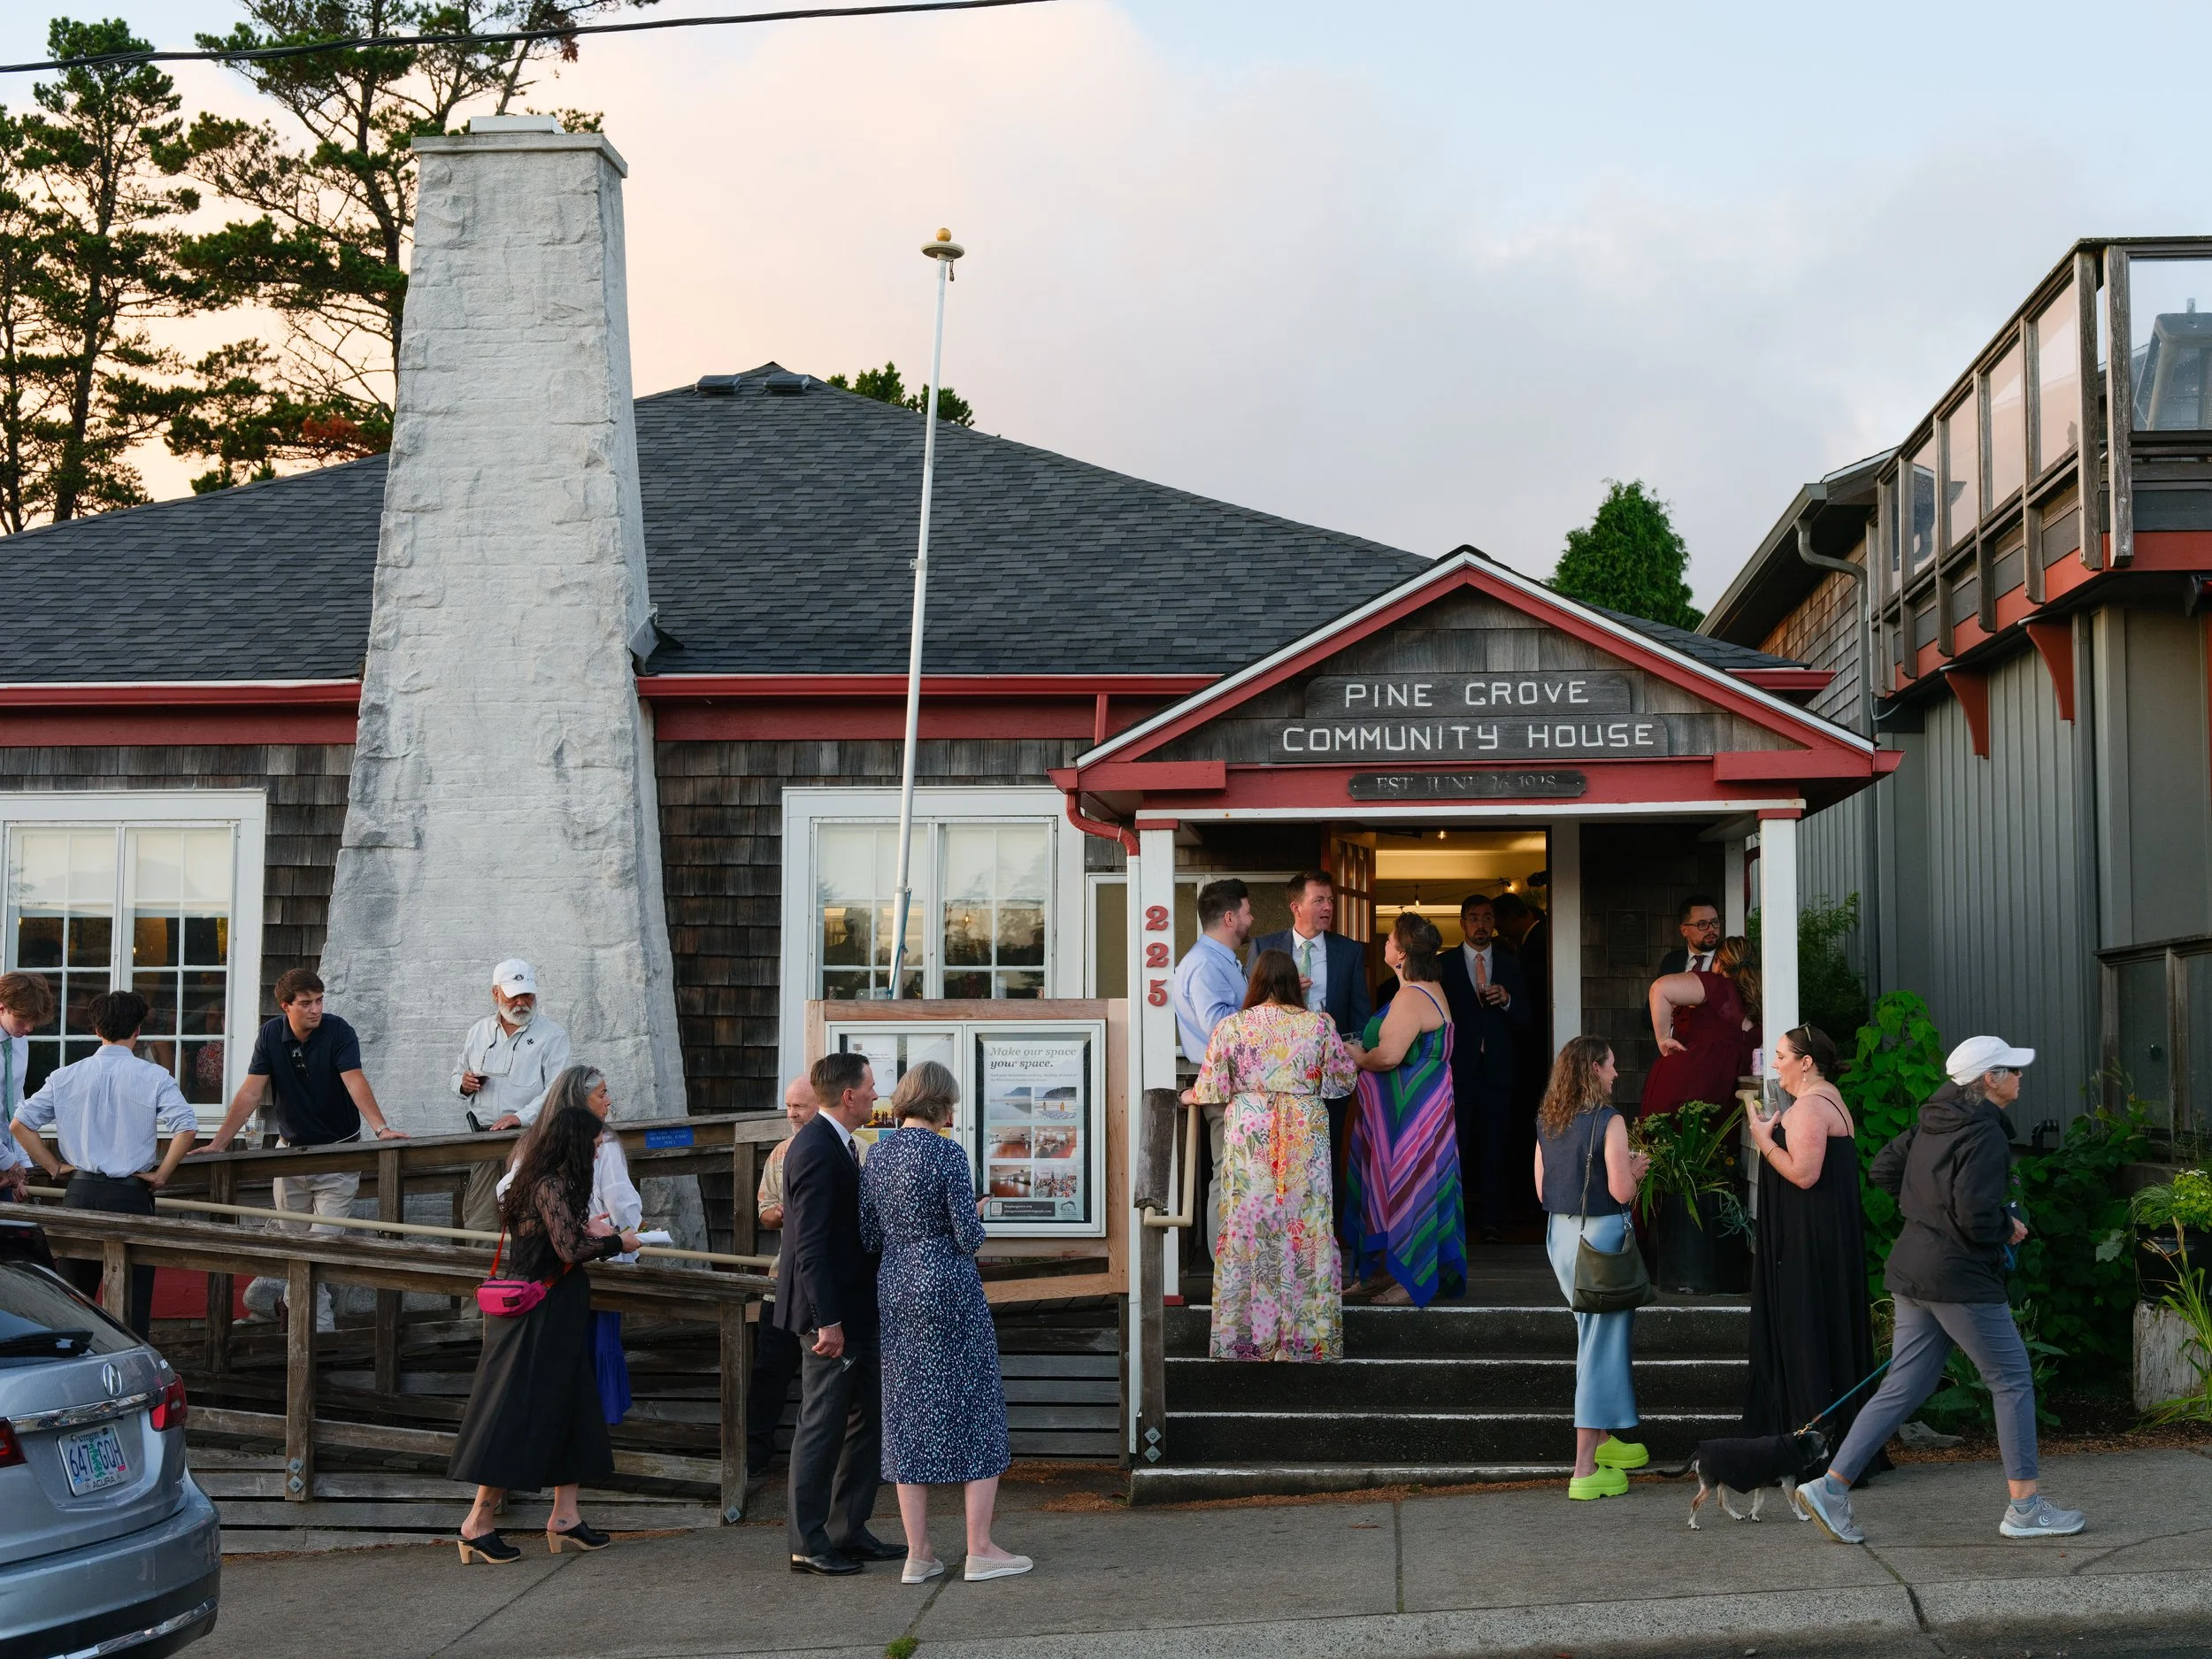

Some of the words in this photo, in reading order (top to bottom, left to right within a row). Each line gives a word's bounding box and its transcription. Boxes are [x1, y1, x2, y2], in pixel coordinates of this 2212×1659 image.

[1345, 683, 1433, 708] PINE
[1465, 680, 1589, 706] GROVE
[1282, 725, 1498, 752] COMMUNITY
[1527, 723, 1654, 749] HOUSE
[990, 1047, 1021, 1056] Make
[1045, 1048, 1077, 1058] space
[990, 1061, 1017, 1070] your
[1019, 1060, 1054, 1070] space.
[92, 1475, 116, 1489] ACURA
